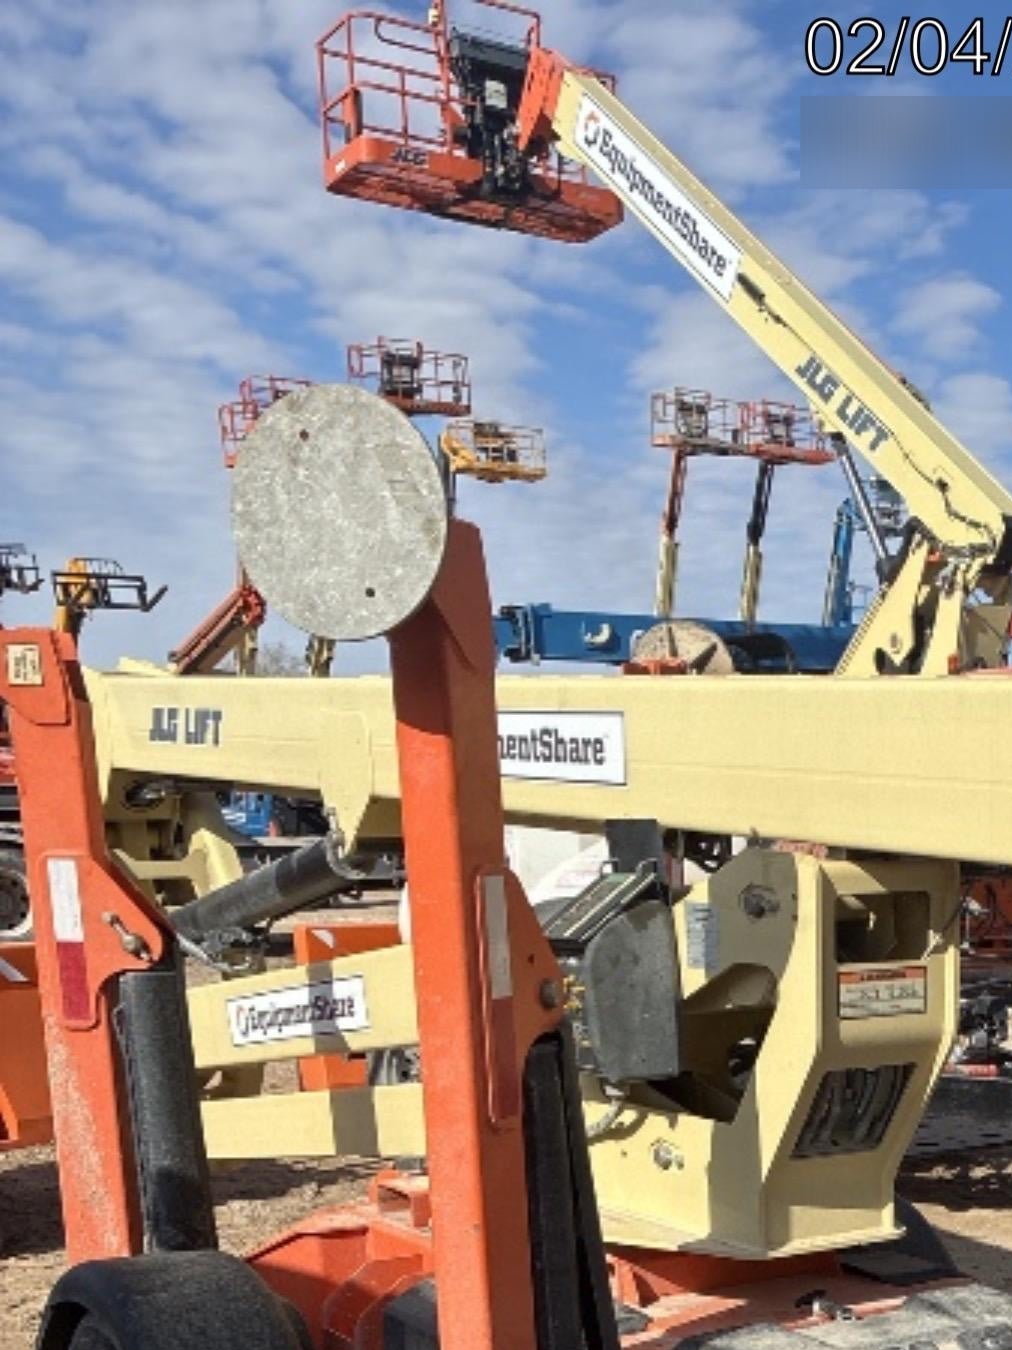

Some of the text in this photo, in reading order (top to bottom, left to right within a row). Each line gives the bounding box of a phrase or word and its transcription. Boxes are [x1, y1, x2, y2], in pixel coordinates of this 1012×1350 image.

[598, 127, 727, 277] EquipmentShare
[795, 356, 889, 451] JLG LIFT
[149, 707, 222, 747] JLG LIFT
